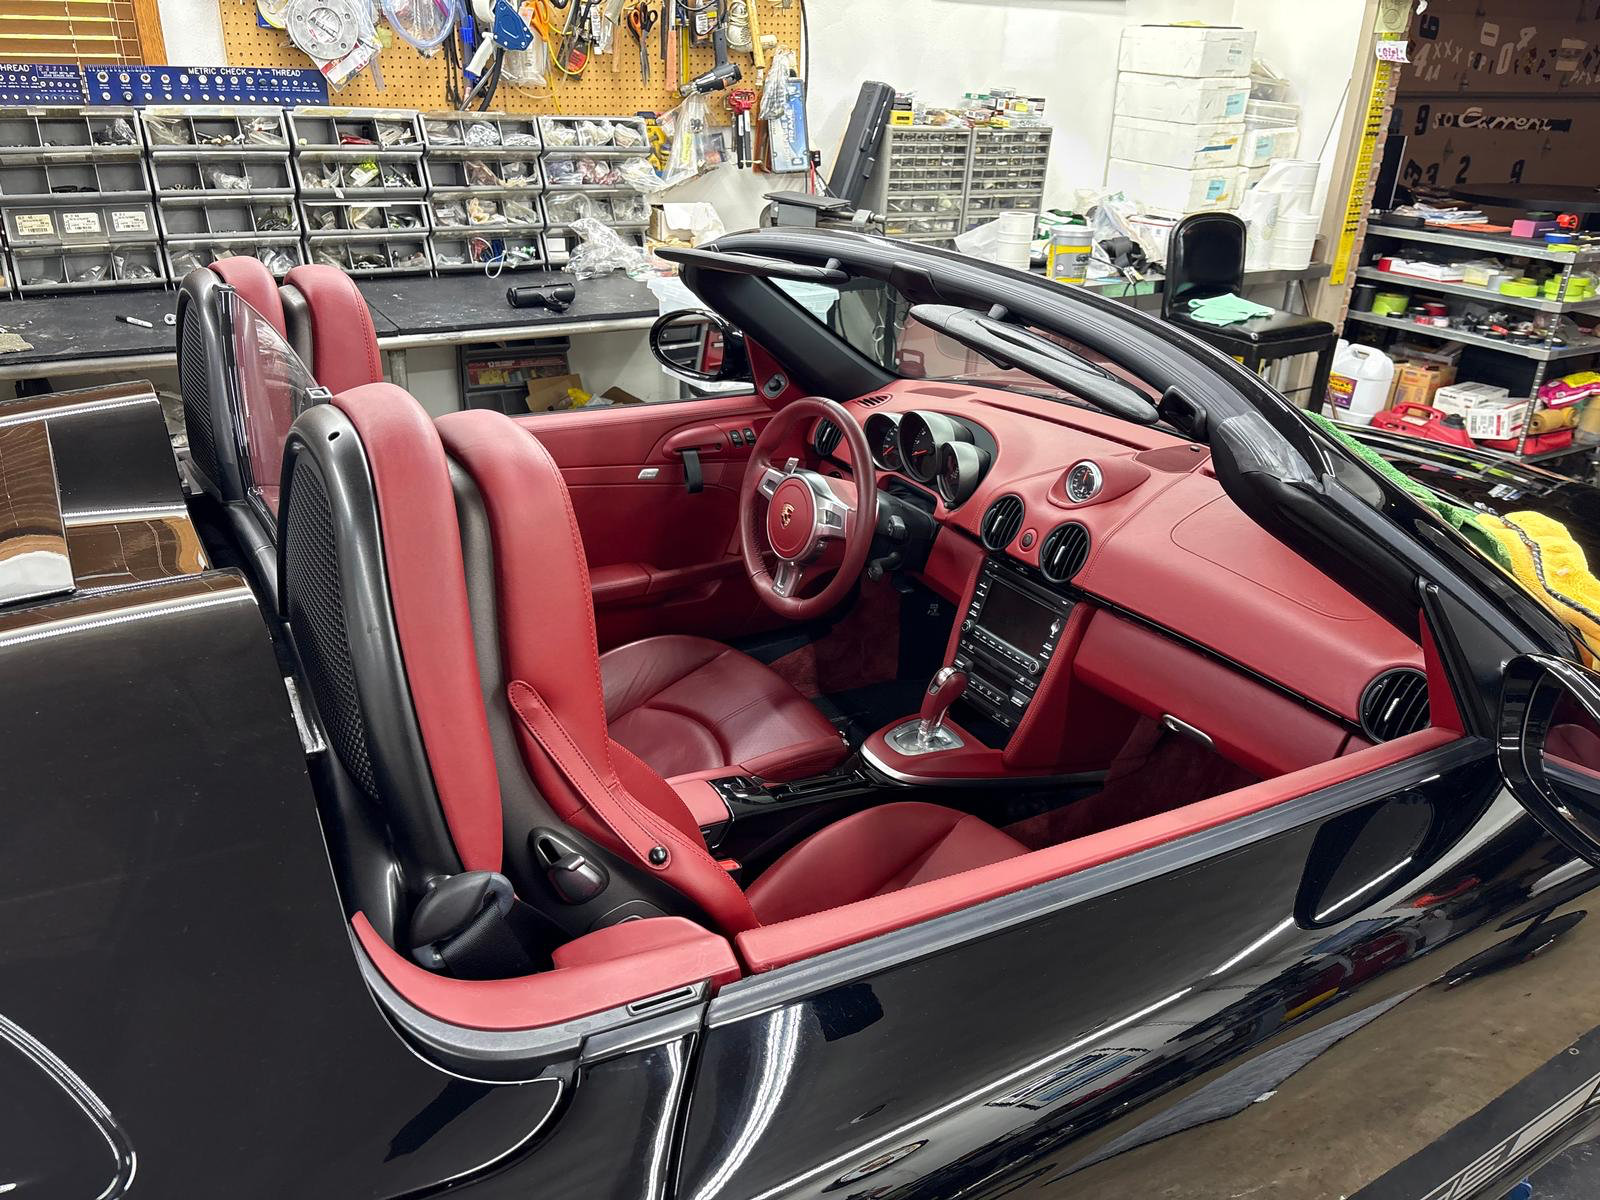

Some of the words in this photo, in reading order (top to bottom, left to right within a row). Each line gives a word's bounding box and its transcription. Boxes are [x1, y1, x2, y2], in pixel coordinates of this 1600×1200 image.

[0, 64, 30, 72] HREAD
[220, 68, 247, 76] CHECK
[271, 69, 302, 77] THREAD
